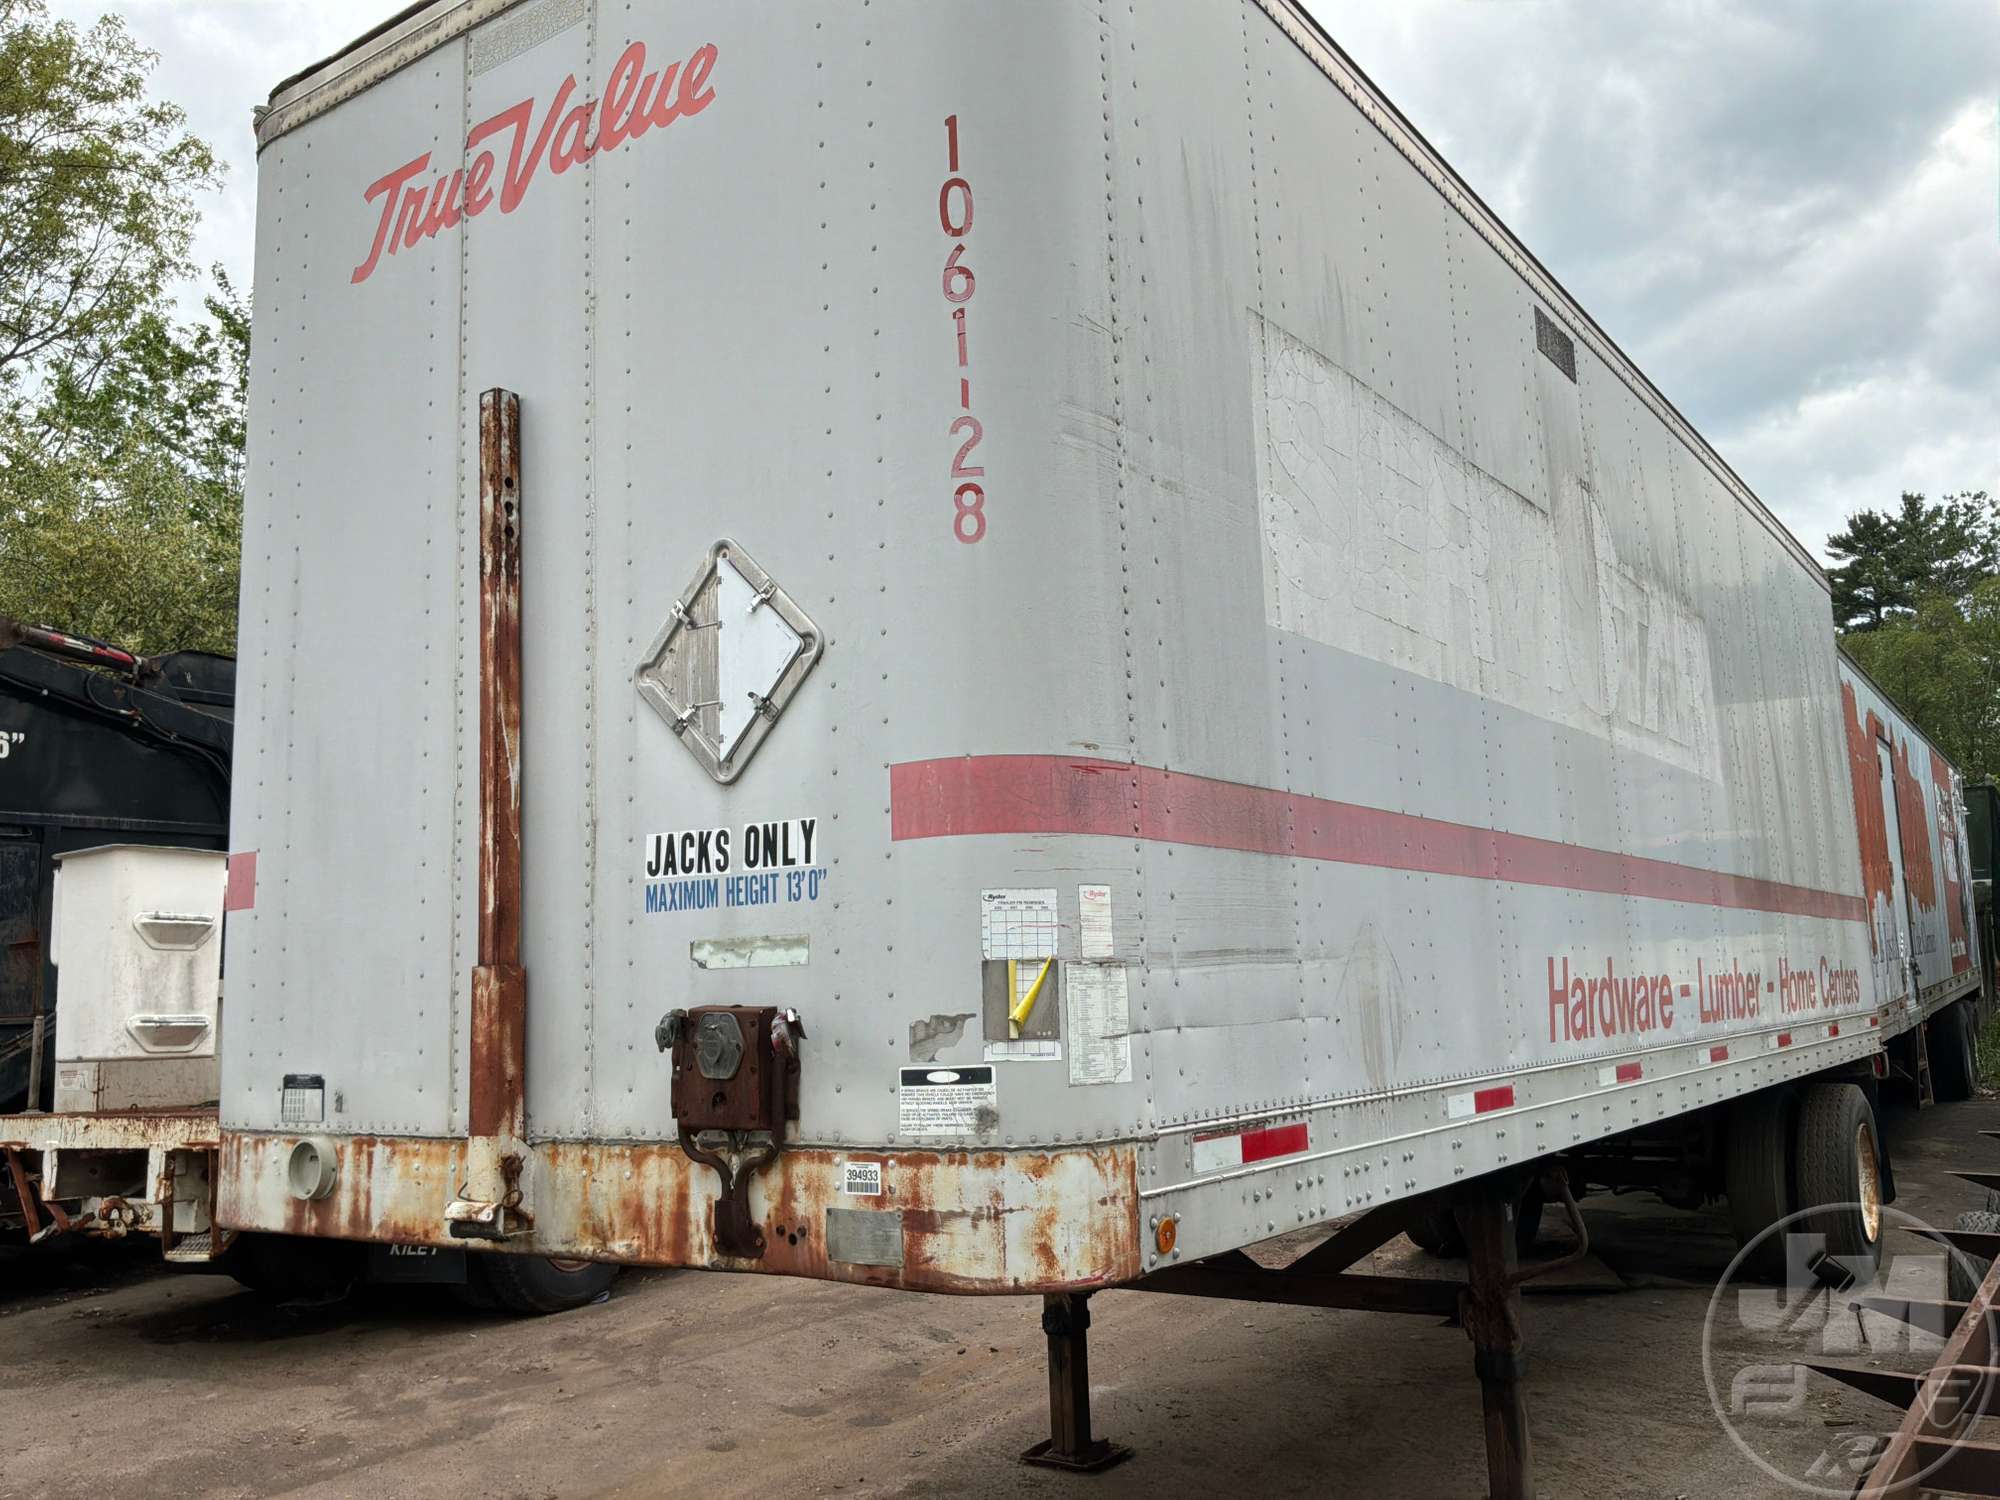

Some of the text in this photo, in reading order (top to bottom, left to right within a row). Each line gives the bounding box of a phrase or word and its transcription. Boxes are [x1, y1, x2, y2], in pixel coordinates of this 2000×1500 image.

[647, 819, 816, 877] JACKS ONLY
[645, 877, 719, 914] MAXIMUM
[726, 873, 780, 908] HEIGHT
[1547, 956, 1674, 1043] Hardware
[1697, 956, 1761, 1025] Lumber
[1778, 956, 1816, 1015] Home
[1820, 955, 1861, 1009] Centers
[846, 1169, 879, 1182] 394933
